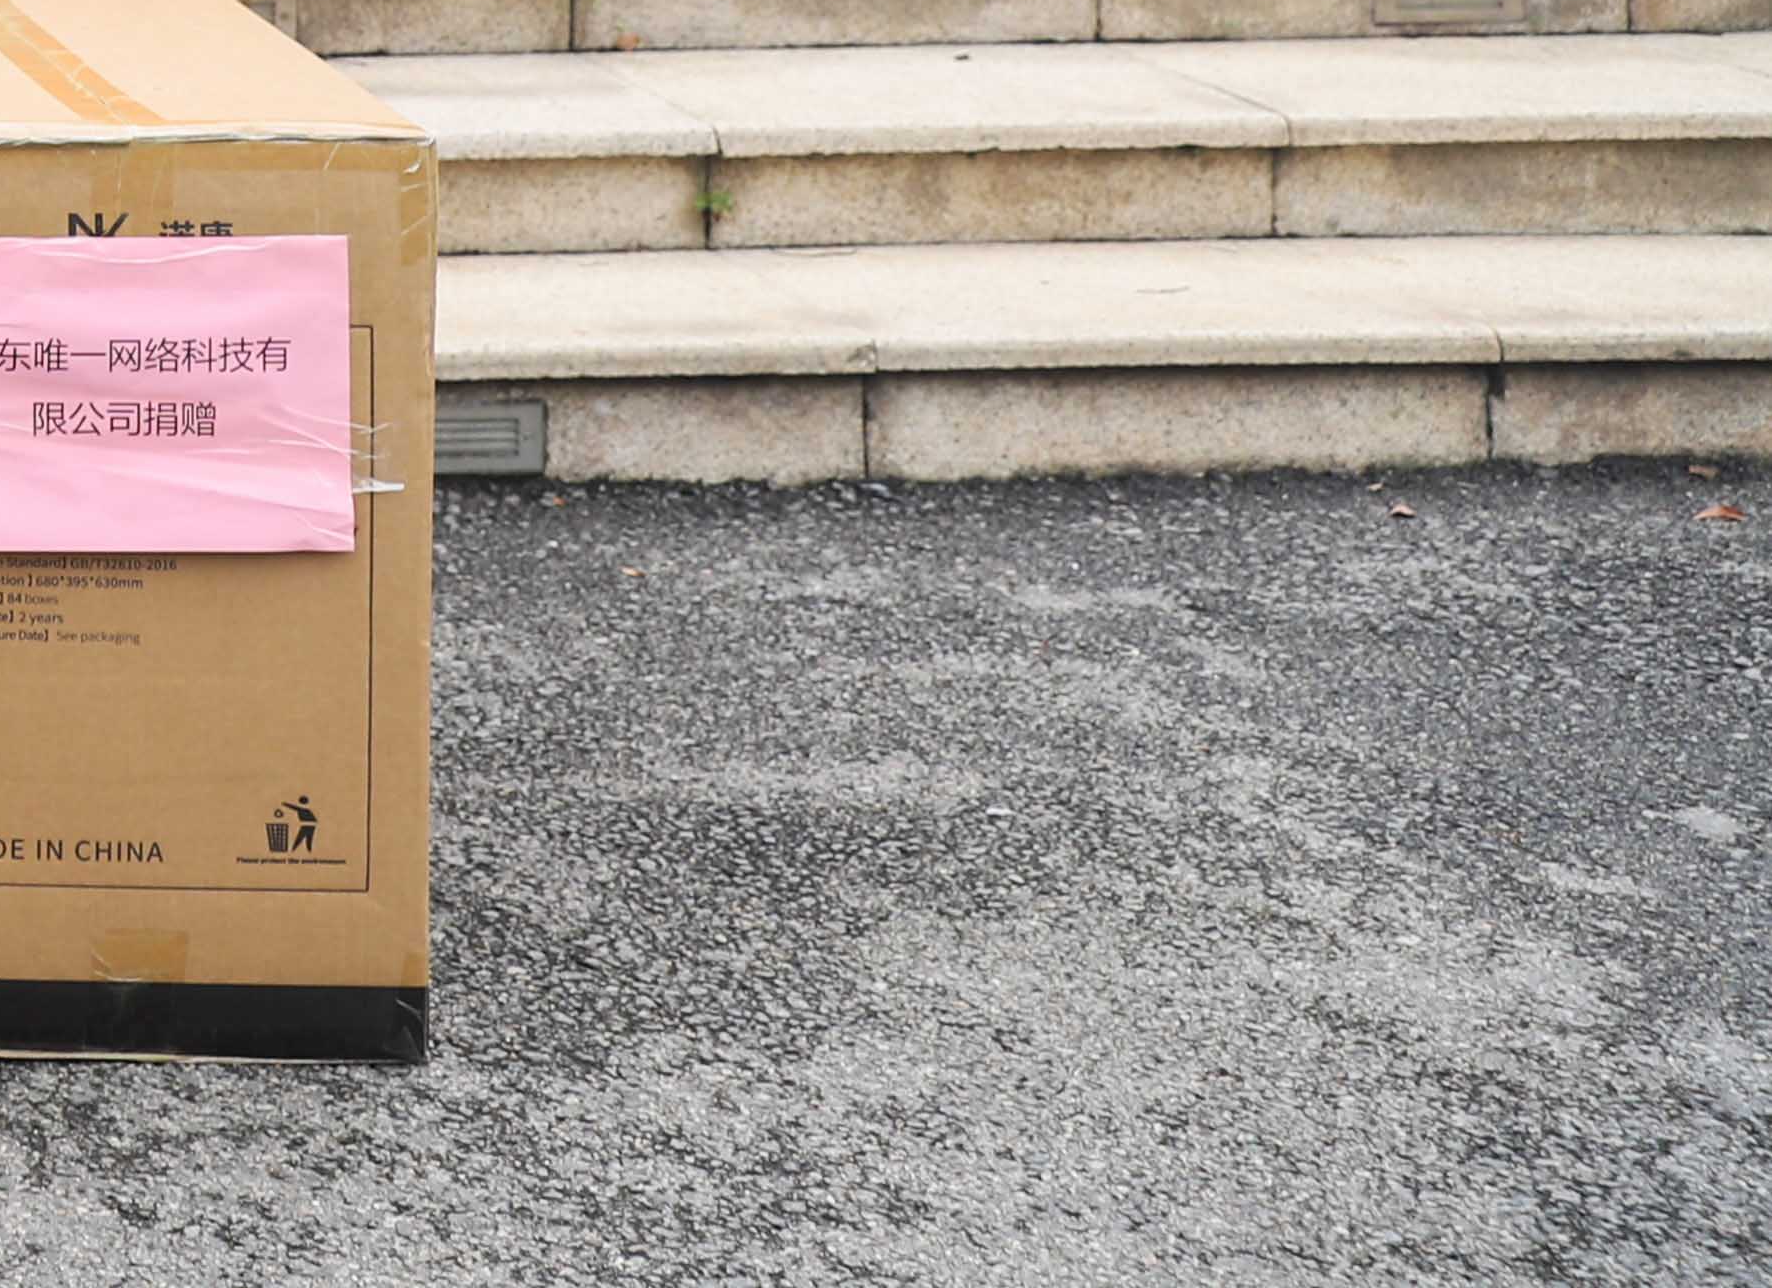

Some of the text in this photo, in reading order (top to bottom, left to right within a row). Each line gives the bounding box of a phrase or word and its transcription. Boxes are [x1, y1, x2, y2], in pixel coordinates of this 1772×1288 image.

[31, 401, 217, 437] 限公司捐赠
[6, 593, 22, 604] 84
[24, 593, 59, 606] boxes
[19, 612, 26, 623] 2
[29, 613, 64, 625] years
[56, 630, 78, 642] See
[80, 631, 141, 645] packaging
[36, 838, 63, 862] IN
[74, 839, 164, 863] CHINA
